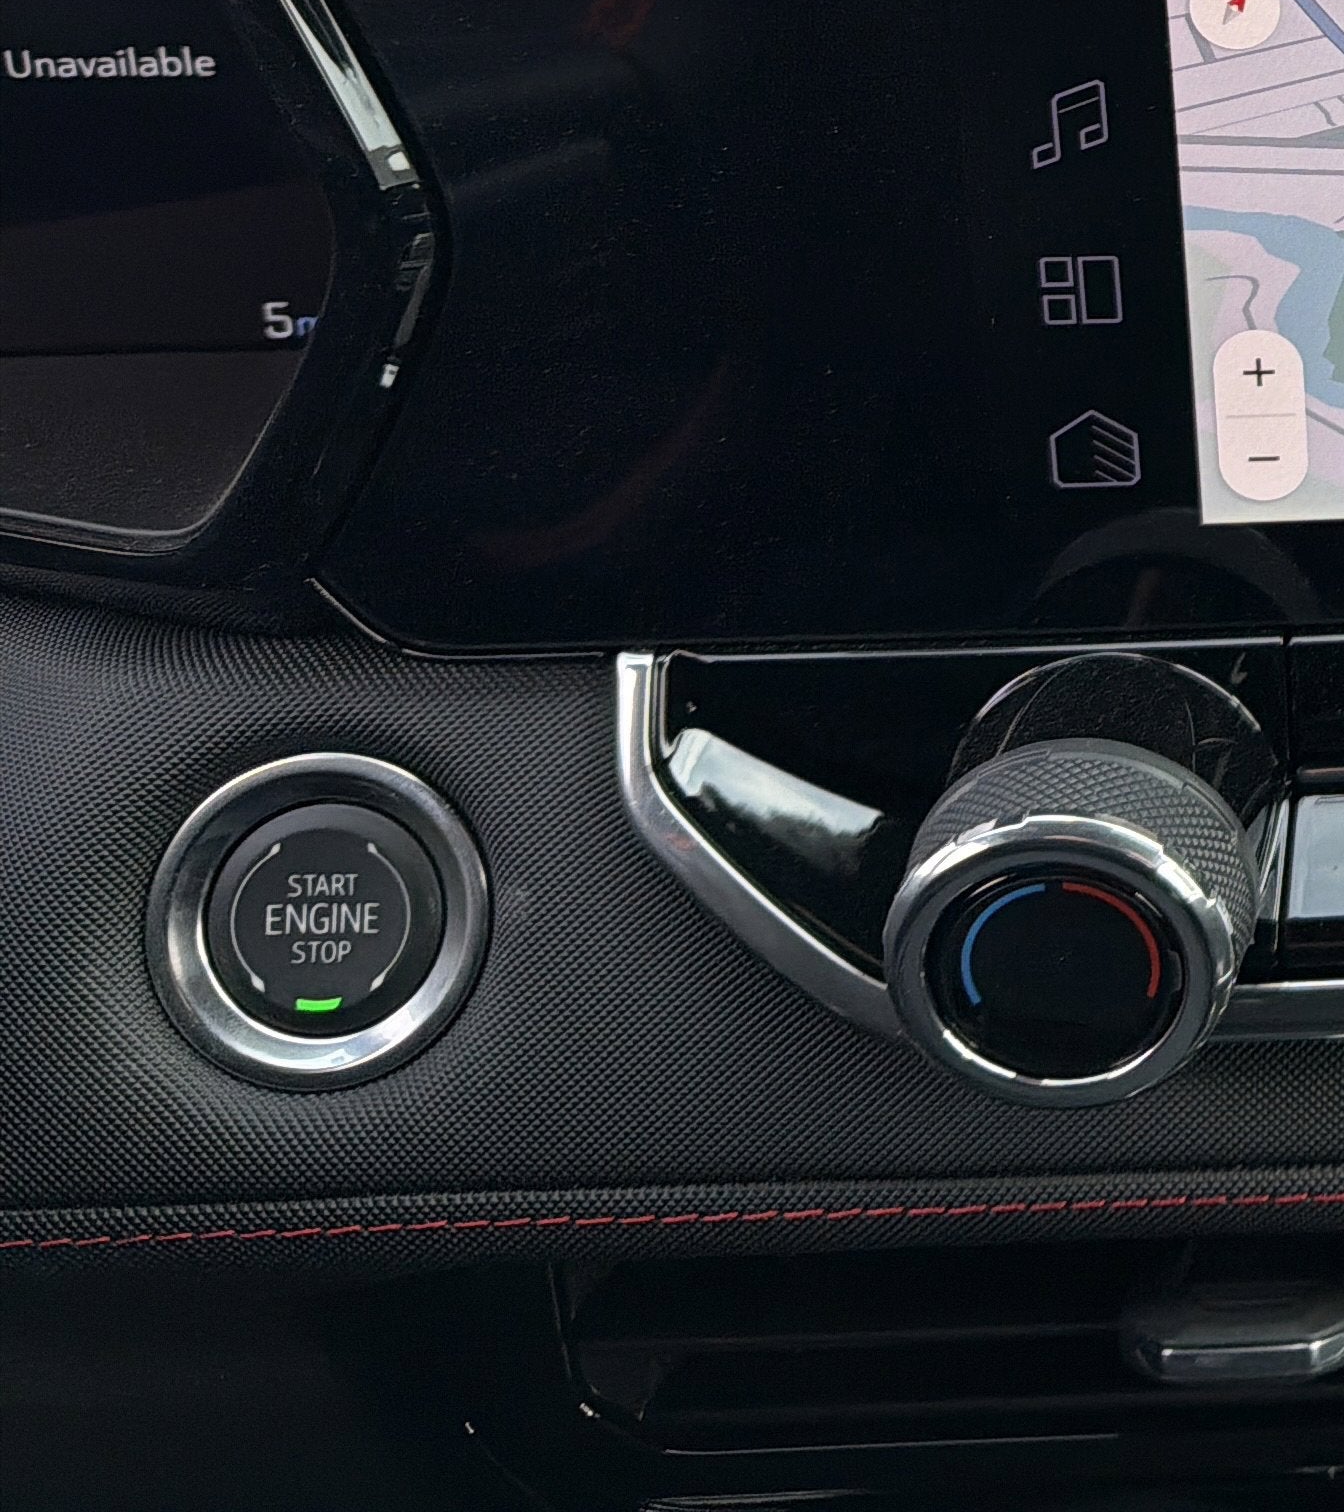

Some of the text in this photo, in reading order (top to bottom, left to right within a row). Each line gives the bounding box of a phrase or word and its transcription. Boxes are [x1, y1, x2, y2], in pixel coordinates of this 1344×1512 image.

[3, 45, 216, 80] Unavailable
[287, 872, 359, 898] START
[264, 902, 381, 936] ENGINE
[291, 940, 352, 964] STOP
